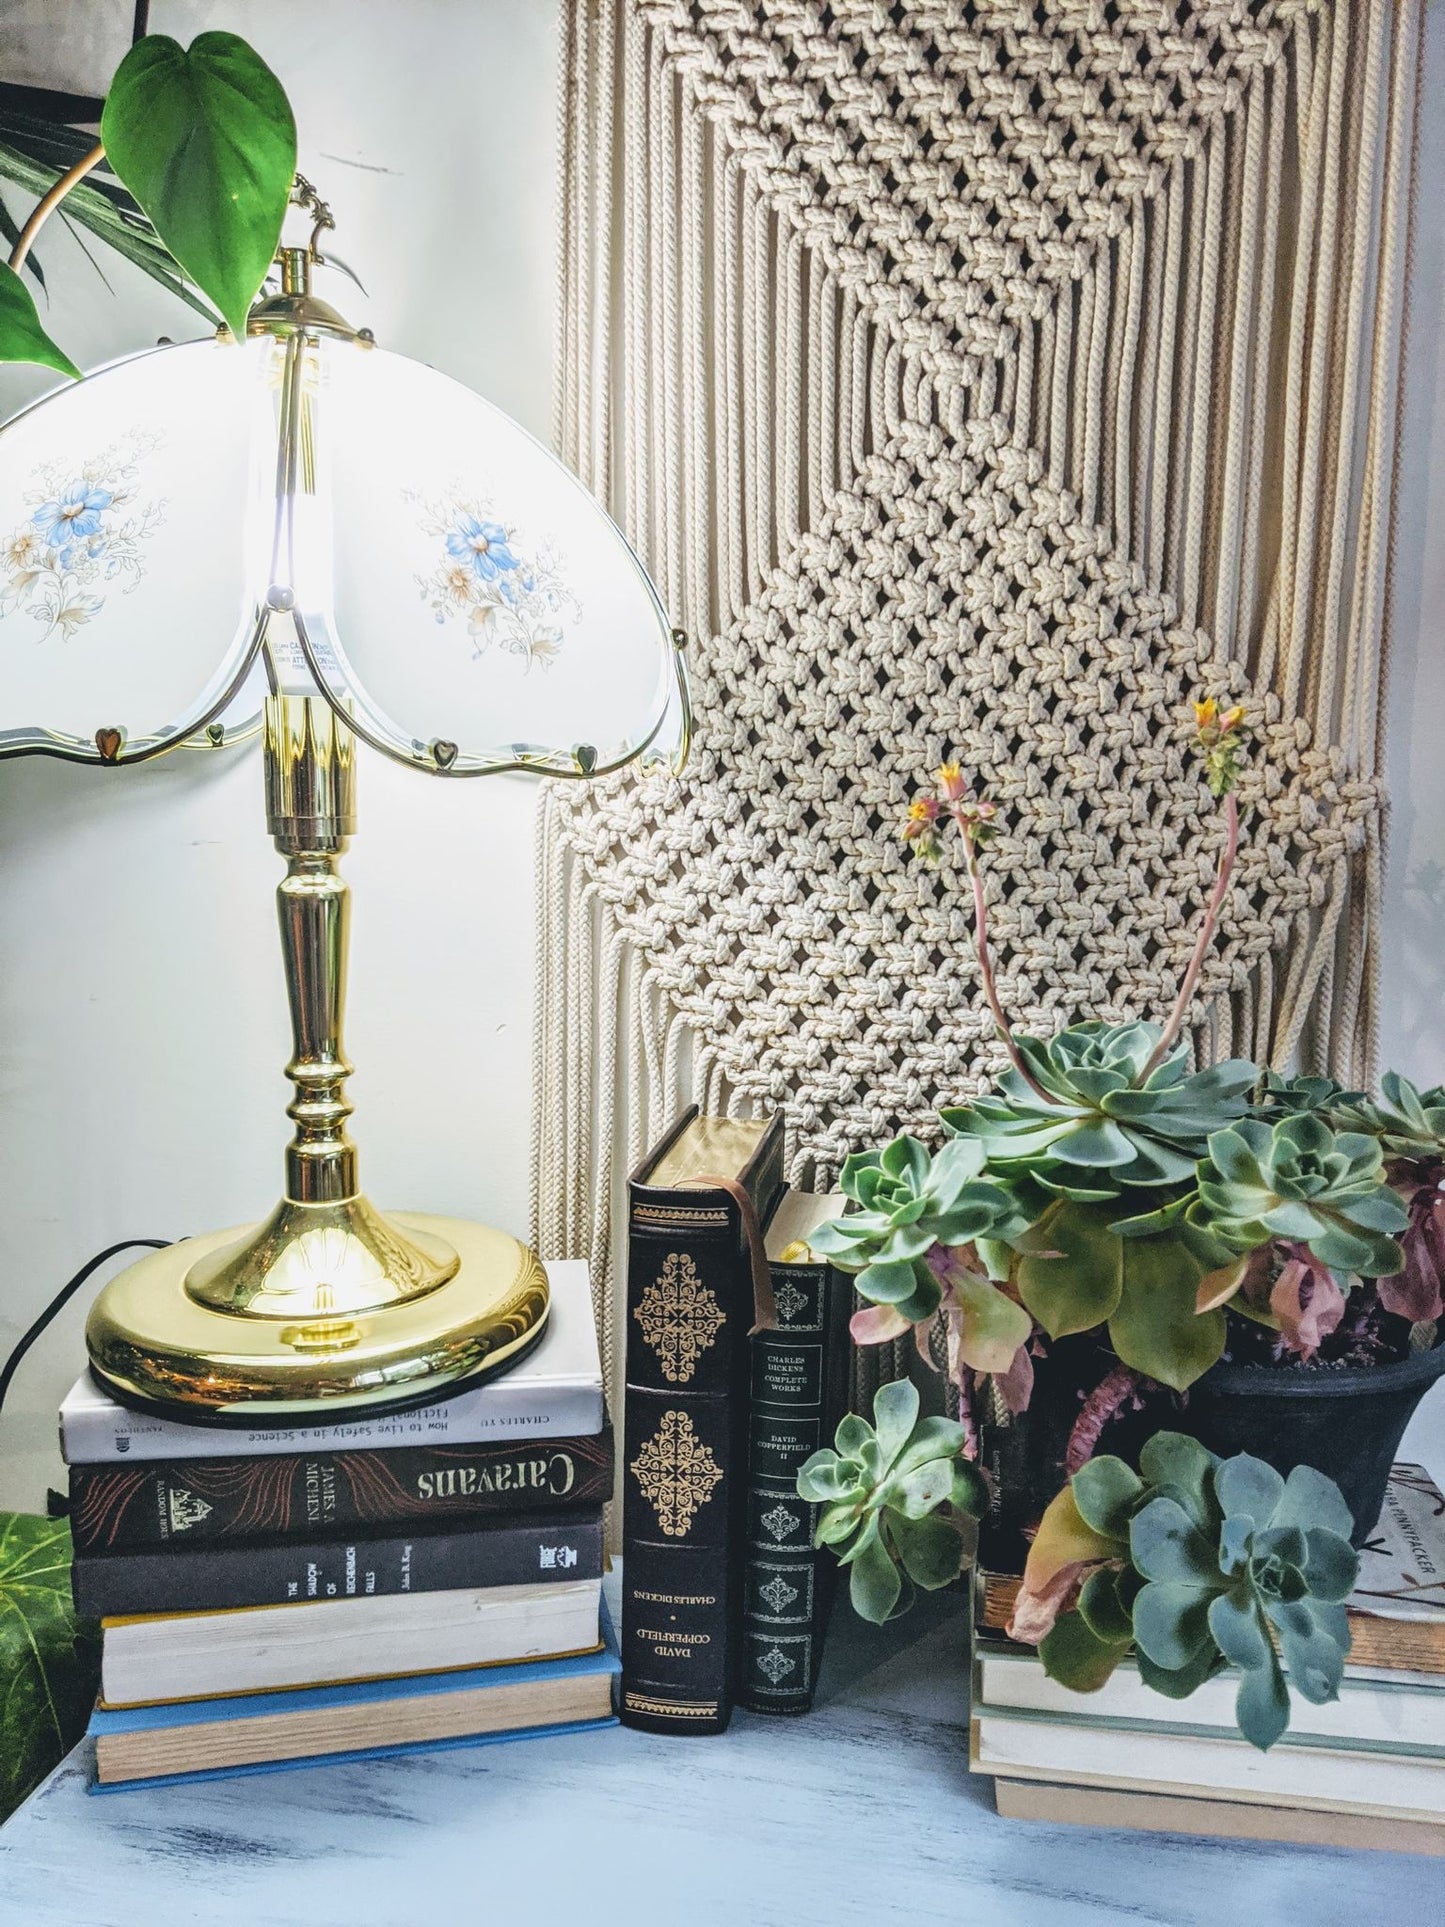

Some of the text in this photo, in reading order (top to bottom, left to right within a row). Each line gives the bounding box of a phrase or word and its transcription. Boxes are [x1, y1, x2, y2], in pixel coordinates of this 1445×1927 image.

[767, 1355, 805, 1364] CHARLES
[768, 1363, 804, 1372] DICKENS
[764, 1375, 808, 1384] COMPLETE
[771, 1384, 801, 1392] WORKS
[500, 1415, 550, 1425] CHARLES
[249, 1422, 448, 1441] How to Live Safely in a Science
[757, 1441, 811, 1451] COPPERFIELD
[771, 1435, 797, 1443] DAVID
[417, 1453, 575, 1500] Caravans
[321, 1466, 336, 1510] JAMES
[156, 1480, 167, 1516] RANDOM
[1392, 1508, 1437, 1573] PENNYPACKER
[346, 1546, 356, 1594] REICHENBACH
[307, 1563, 317, 1596] SHADOW
[365, 1571, 375, 1593] FALLS
[288, 1582, 298, 1597] THE
[327, 1582, 336, 1595] OF
[633, 1590, 716, 1604] CHARLES DICKENS
[636, 1629, 711, 1644] COPPERFIELD
[654, 1646, 691, 1658] DAVID
